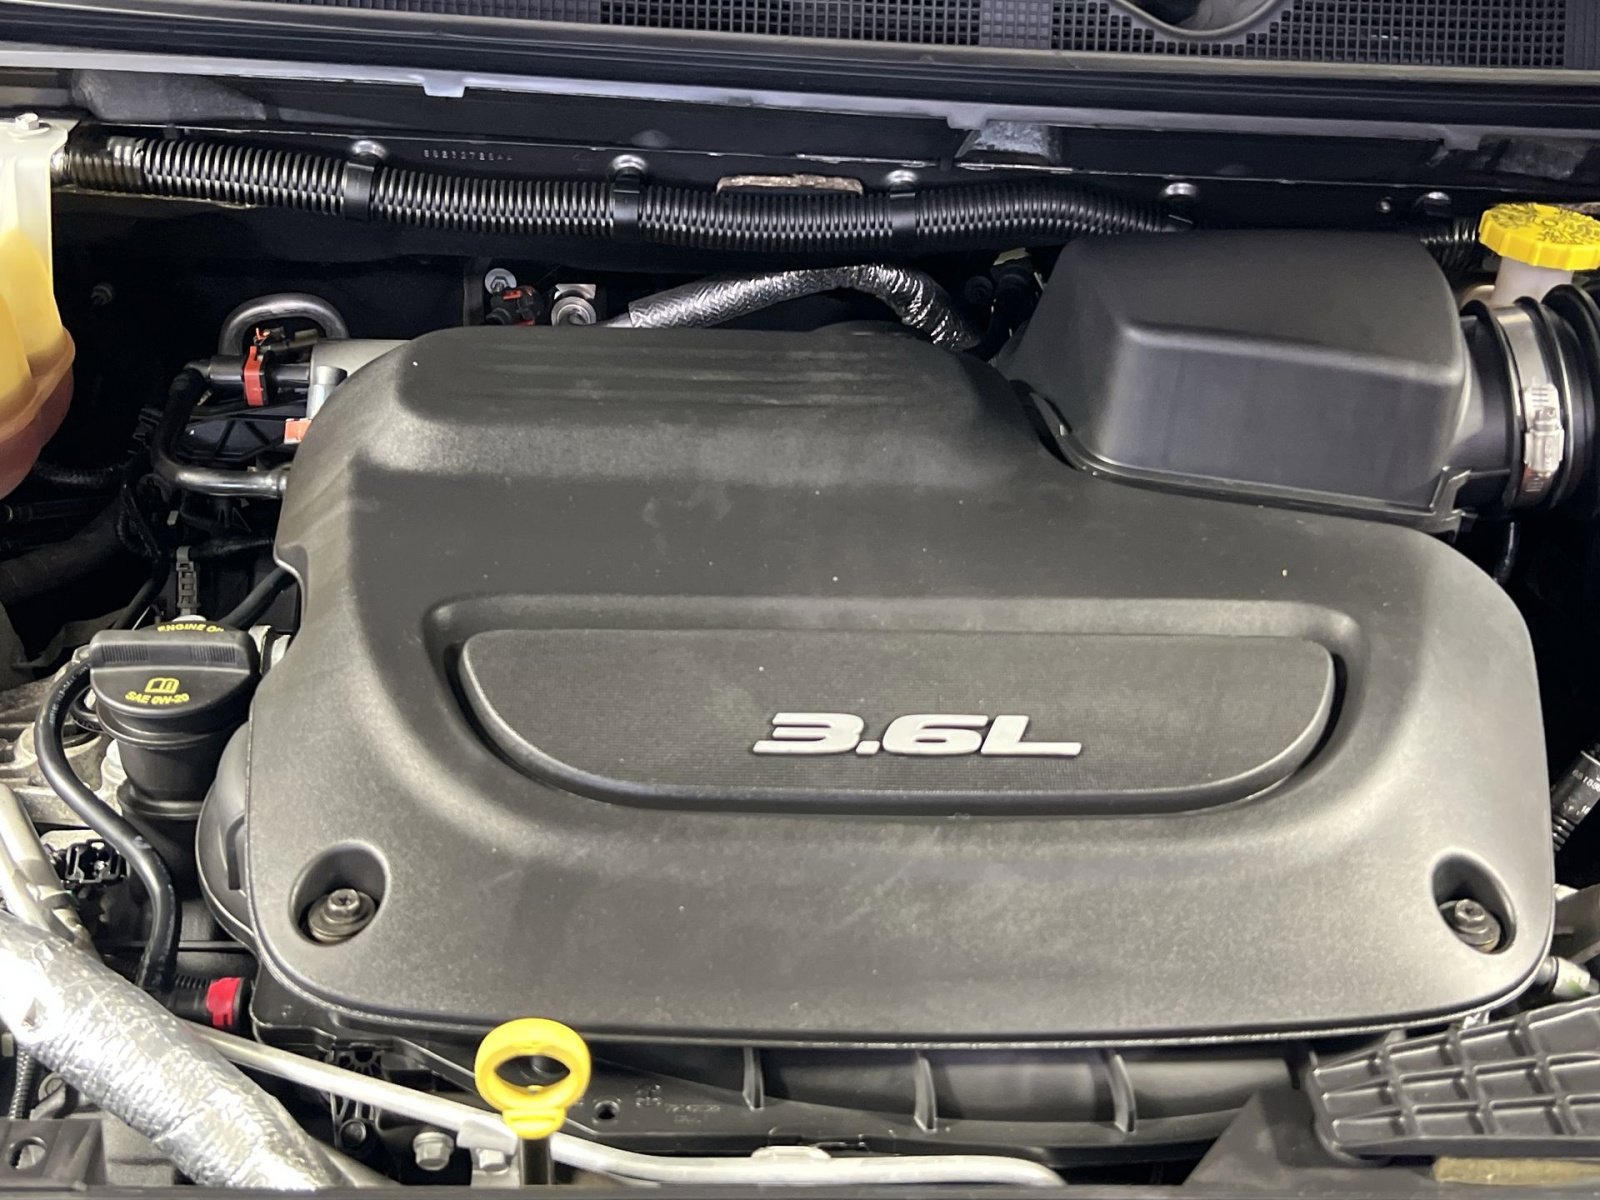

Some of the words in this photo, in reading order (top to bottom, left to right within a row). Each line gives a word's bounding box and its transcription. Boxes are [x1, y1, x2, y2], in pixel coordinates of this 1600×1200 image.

[125, 690, 151, 704] SAE
[151, 693, 190, 705] 0W-20
[753, 712, 1082, 756] 3.6L
